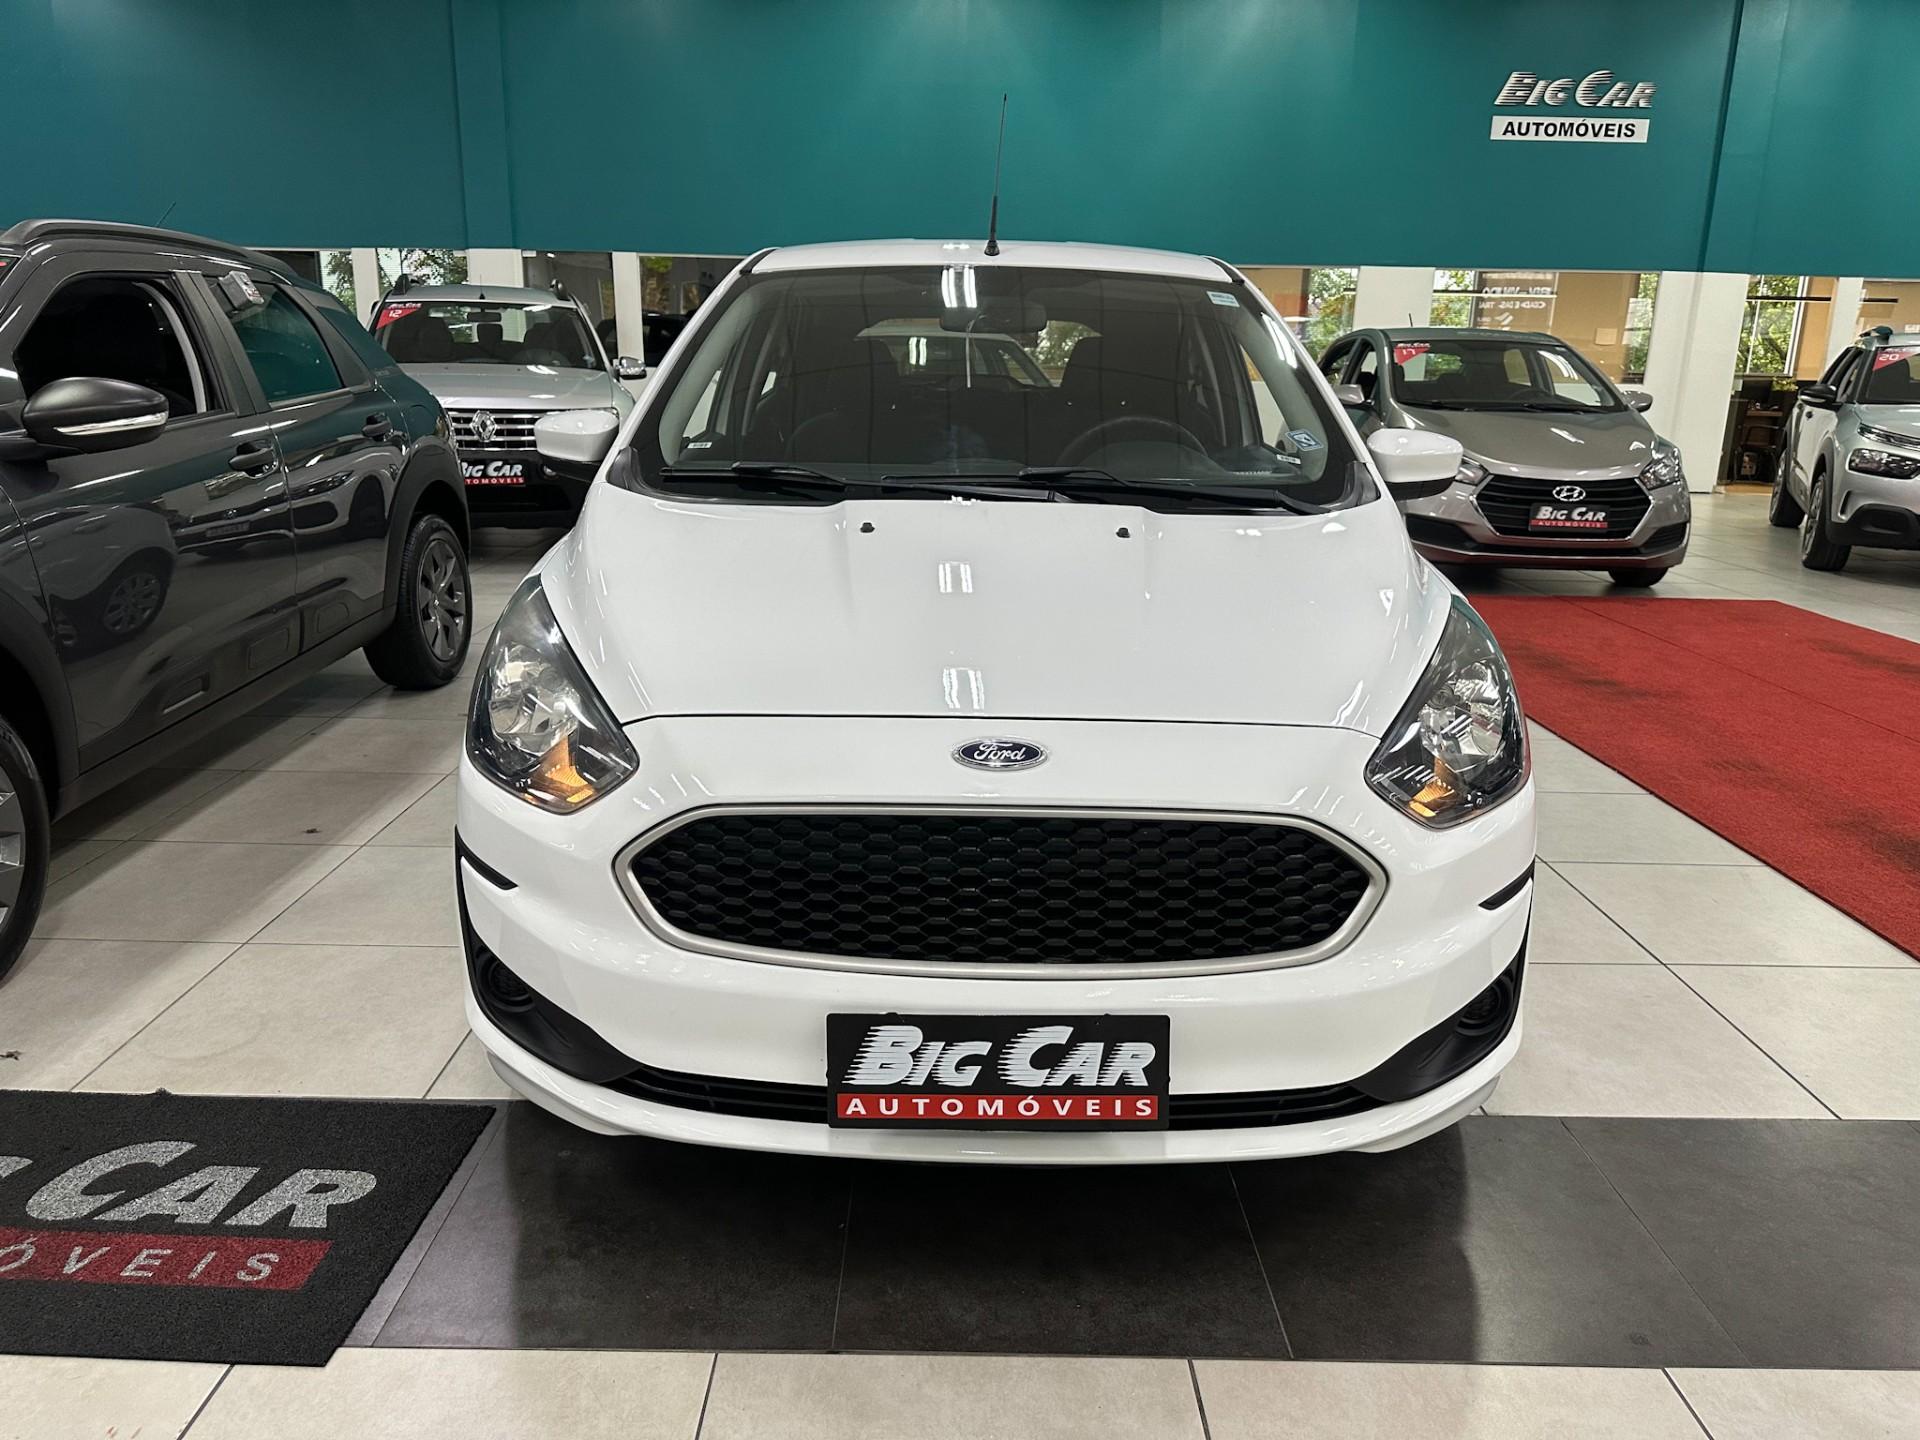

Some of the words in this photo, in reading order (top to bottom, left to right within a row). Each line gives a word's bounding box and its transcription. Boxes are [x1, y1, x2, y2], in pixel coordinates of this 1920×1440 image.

[1575, 69, 1657, 108] CAR
[1502, 118, 1636, 138] AUTOMÓVEIS
[1879, 353, 1900, 361] 20
[486, 460, 523, 477] CAR
[1536, 506, 1568, 520] BIG
[1571, 507, 1606, 521] CAR
[973, 741, 1027, 760] Ford
[841, 1024, 993, 1087] BIG
[997, 1025, 1157, 1087] CAR
[845, 1095, 1153, 1116] AUTOMÓVEIS
[25, 1140, 377, 1229] CAR
